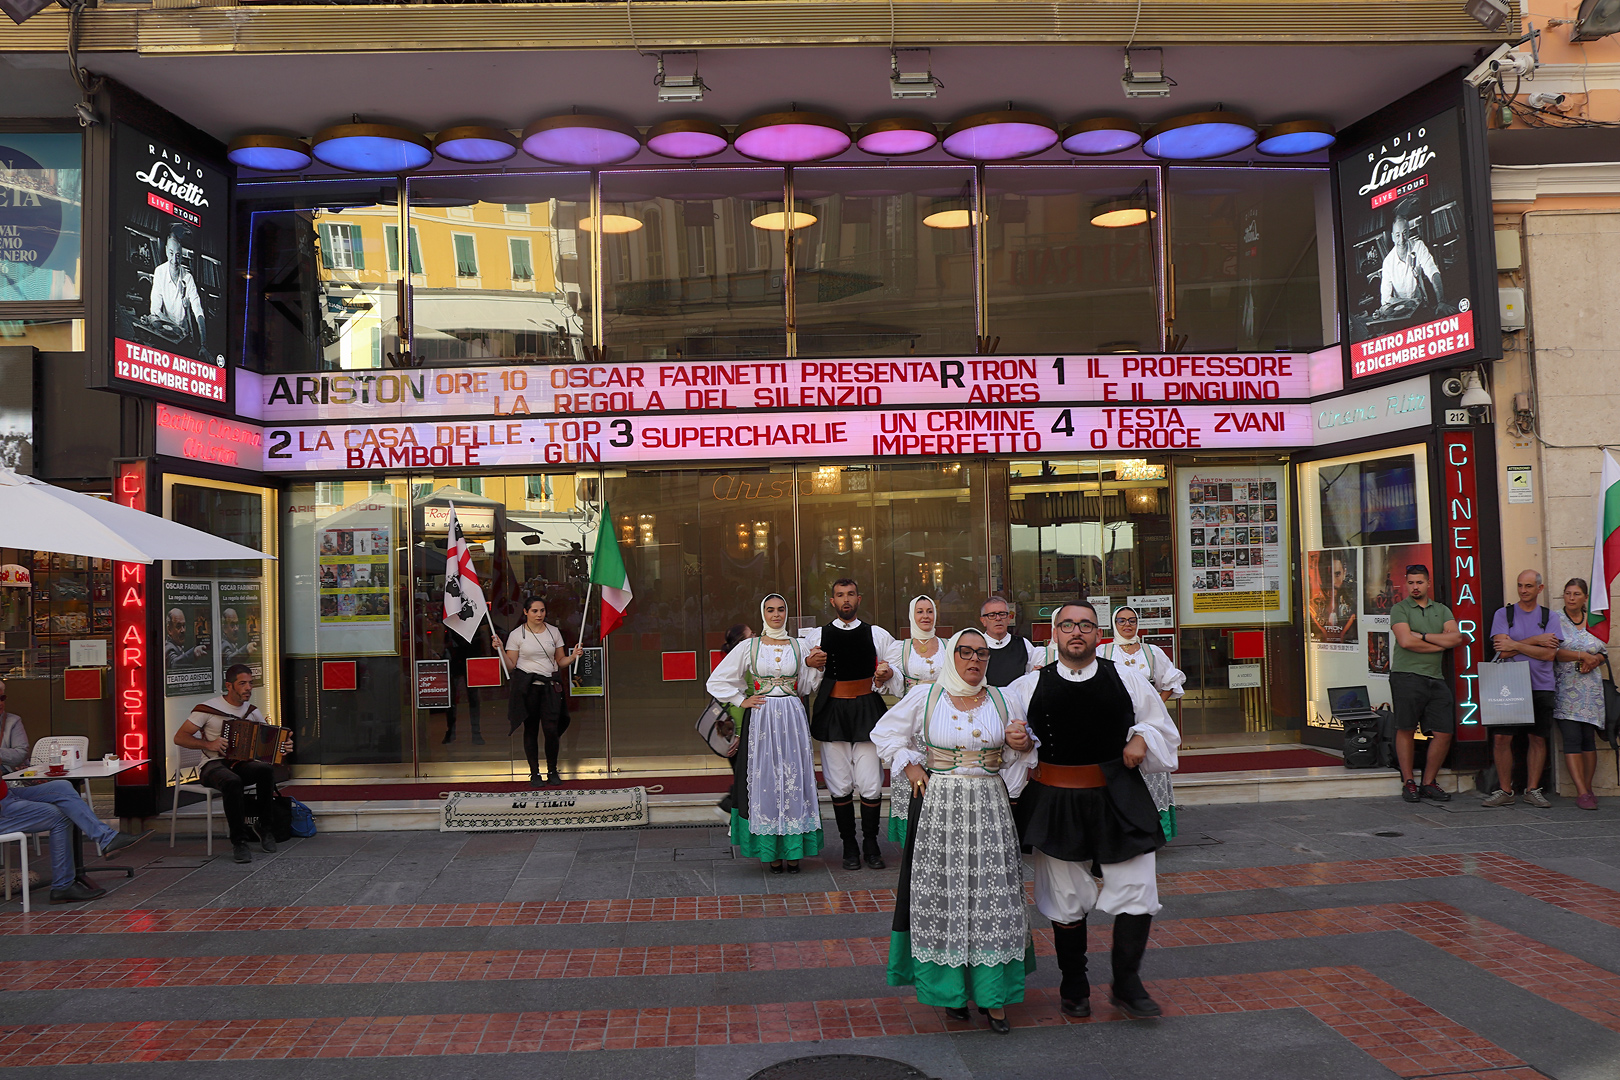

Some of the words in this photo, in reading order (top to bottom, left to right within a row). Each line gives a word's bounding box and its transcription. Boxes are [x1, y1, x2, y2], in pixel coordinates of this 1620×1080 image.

[148, 144, 203, 178] RADIO
[1367, 127, 1426, 163] RADIO
[136, 161, 209, 208] Linetti
[1358, 144, 1436, 196] Linetti
[1374, 192, 1392, 205] LIVE
[1402, 178, 1425, 193] TOUR
[151, 197, 170, 210] LIVE
[178, 210, 198, 224] TOUR
[1361, 334, 1404, 356] TEATRO
[1406, 316, 1460, 344] ARISTON
[126, 344, 170, 368] TEATRO
[172, 357, 217, 382] ARISTON
[1355, 361, 1366, 374] 12
[1367, 345, 1426, 372] DICEMBRE
[1428, 336, 1454, 356] ORE
[1456, 332, 1470, 348] 21
[118, 360, 130, 376] 12
[131, 366, 189, 391] DICEMBRE
[190, 381, 212, 397] ORE
[213, 386, 223, 400] 21
[436, 372, 489, 394] ORE
[499, 370, 528, 392] 10
[550, 367, 645, 389] OSCAR
[659, 362, 787, 387] FARINETTI
[801, 362, 939, 383] PRESENTA
[940, 360, 966, 388] R
[968, 359, 1036, 381] TRON
[1052, 358, 1066, 385] 1
[1088, 358, 1109, 379] IL
[1123, 356, 1292, 378] PROFESSORE
[268, 374, 425, 406] ARISTON
[494, 395, 531, 416] LA
[554, 391, 665, 415] REGOLA
[686, 388, 736, 410] DEL
[754, 386, 882, 408] SILENZIO
[968, 383, 1040, 404] ARES
[1104, 383, 1118, 402] E
[1132, 382, 1153, 402] IL
[1164, 380, 1280, 402] PINGUINO
[208, 418, 262, 447] Cinema
[544, 421, 600, 443] TOP
[609, 418, 634, 448] 3
[642, 422, 848, 448] SUPERCHARLIE
[880, 412, 916, 434] UN
[926, 410, 1035, 432] CRIMINE
[1051, 409, 1074, 437] 4
[1102, 408, 1184, 428] TESTA
[1214, 412, 1286, 432] ZVANI
[1318, 404, 1377, 430] Cinema
[1450, 412, 1465, 422] 212
[268, 430, 292, 460] 2
[299, 431, 335, 452] LA
[344, 427, 418, 450] CASA
[346, 444, 480, 469] BAMBOLE
[544, 442, 600, 464] GUN
[873, 431, 1042, 456] IMPERFETTO
[1090, 429, 1108, 450] O
[1118, 428, 1202, 448] CROCE
[429, 508, 452, 522] Roof
[1449, 443, 1476, 606] CINEMA
[122, 473, 143, 607] CIMA
[166, 582, 184, 590] OSCAR
[168, 674, 188, 683] TEATRO
[1458, 620, 1479, 725] RITZ
[122, 625, 144, 770] ARISTON
